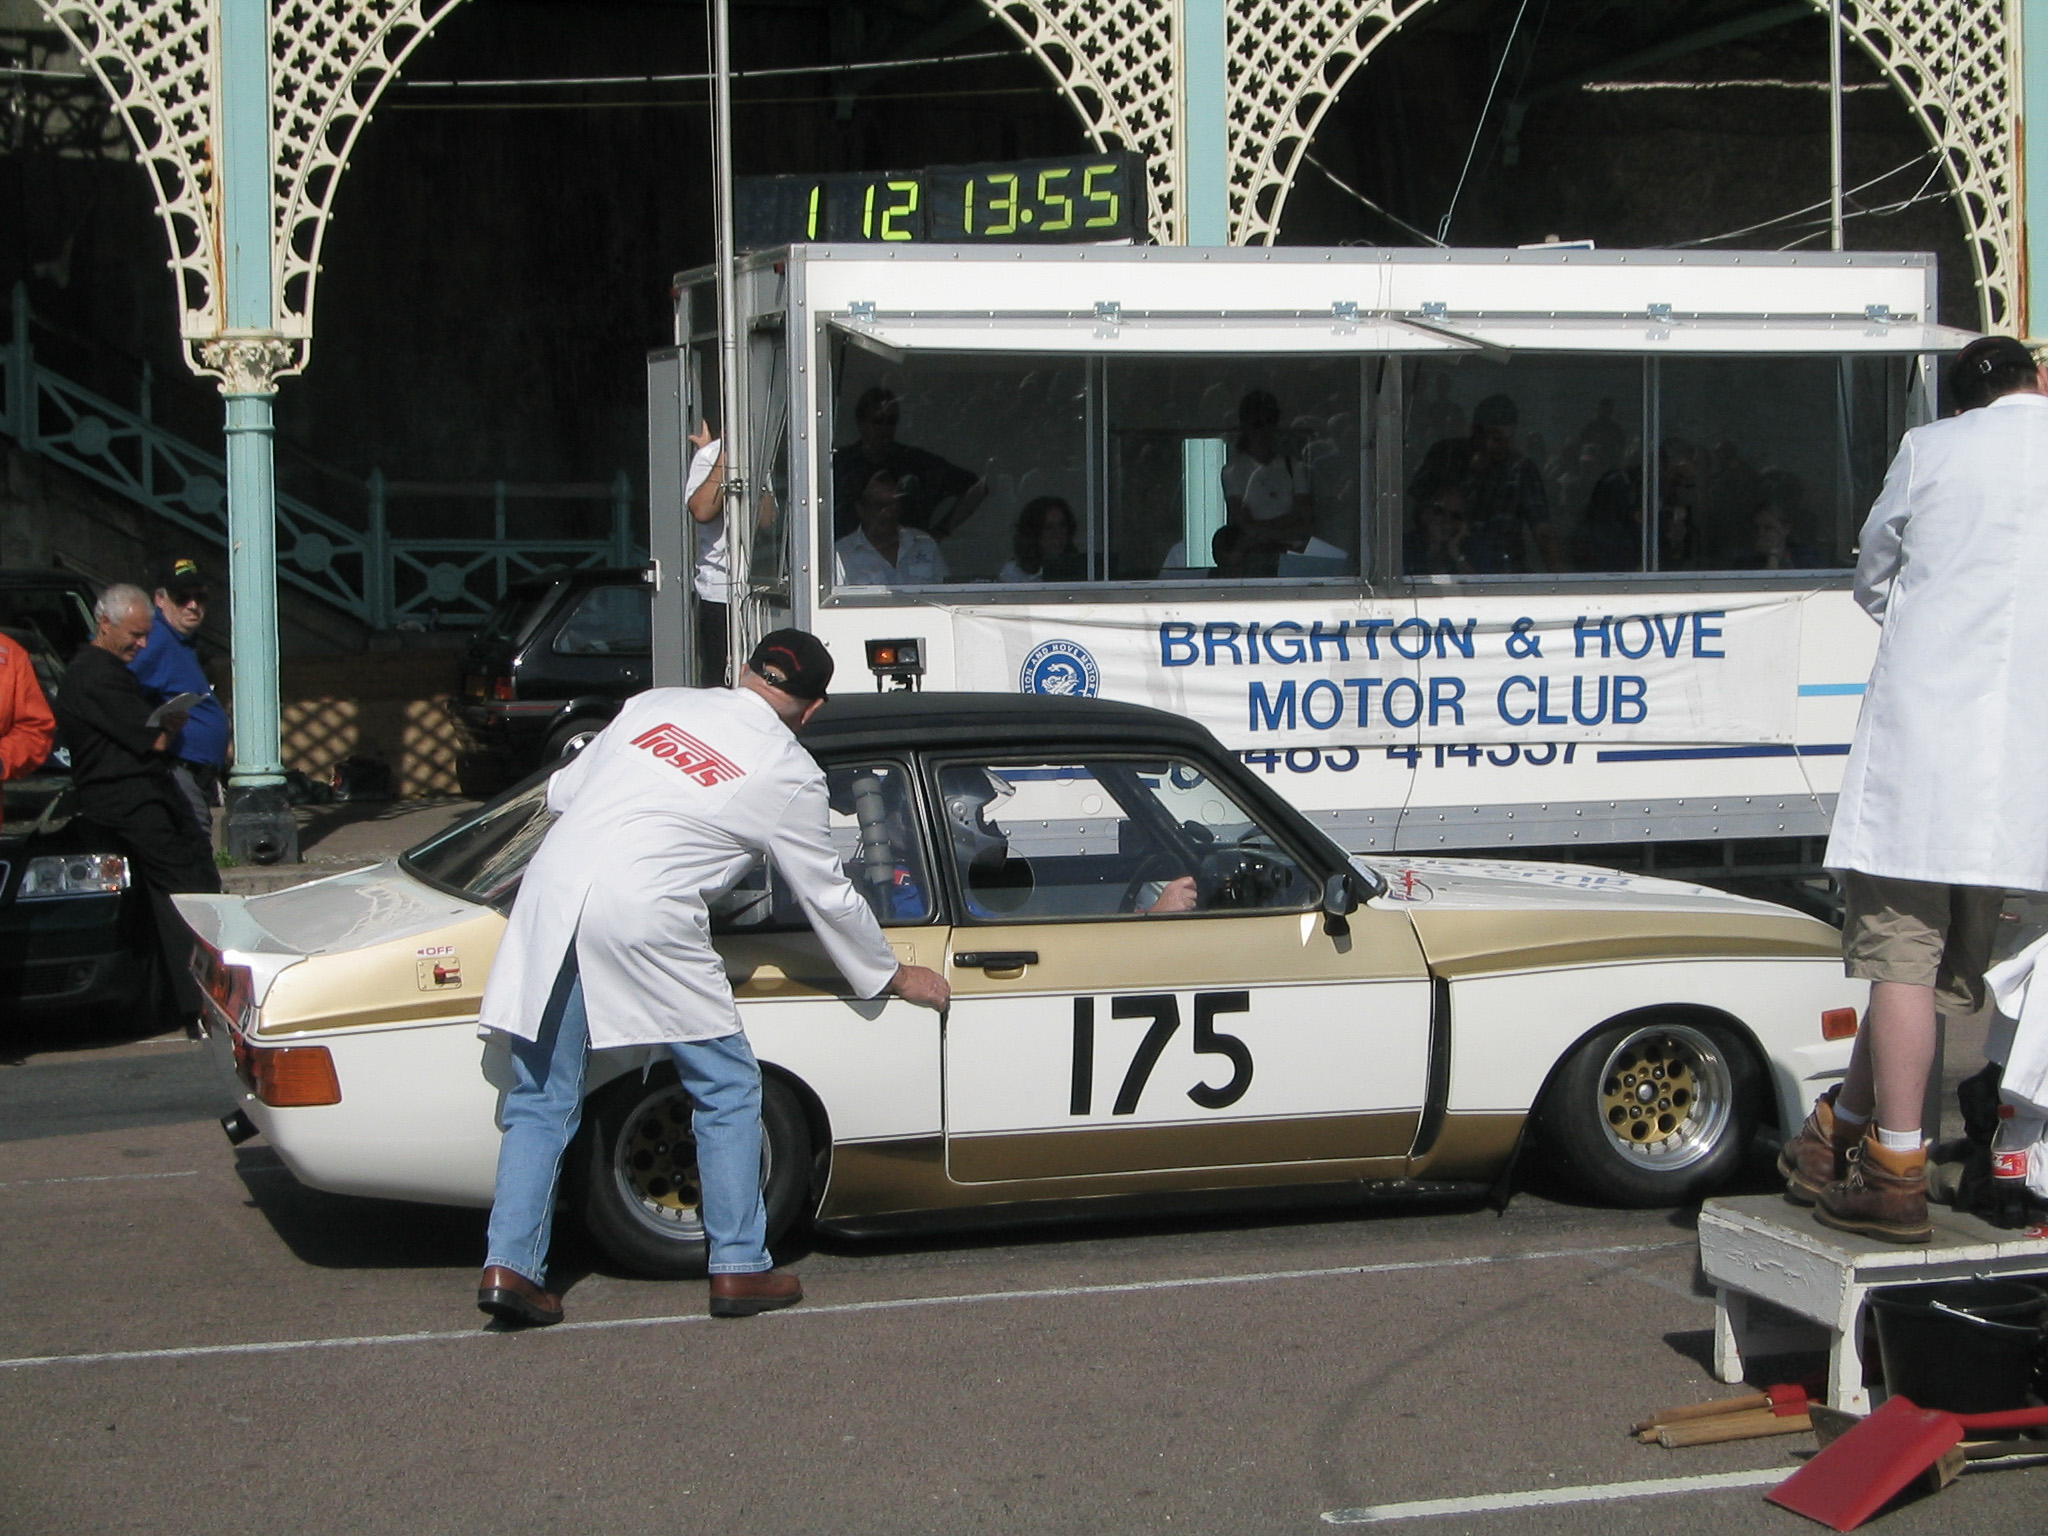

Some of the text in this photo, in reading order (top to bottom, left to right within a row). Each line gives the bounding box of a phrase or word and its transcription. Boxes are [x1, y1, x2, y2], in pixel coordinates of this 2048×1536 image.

[963, 164, 1120, 236] 13.55
[1159, 610, 1727, 667] BRIGHTON & HOVE
[1248, 674, 1649, 732] MOTOR CLUB
[425, 945, 454, 956] OFF
[1069, 989, 1255, 1116] 175
